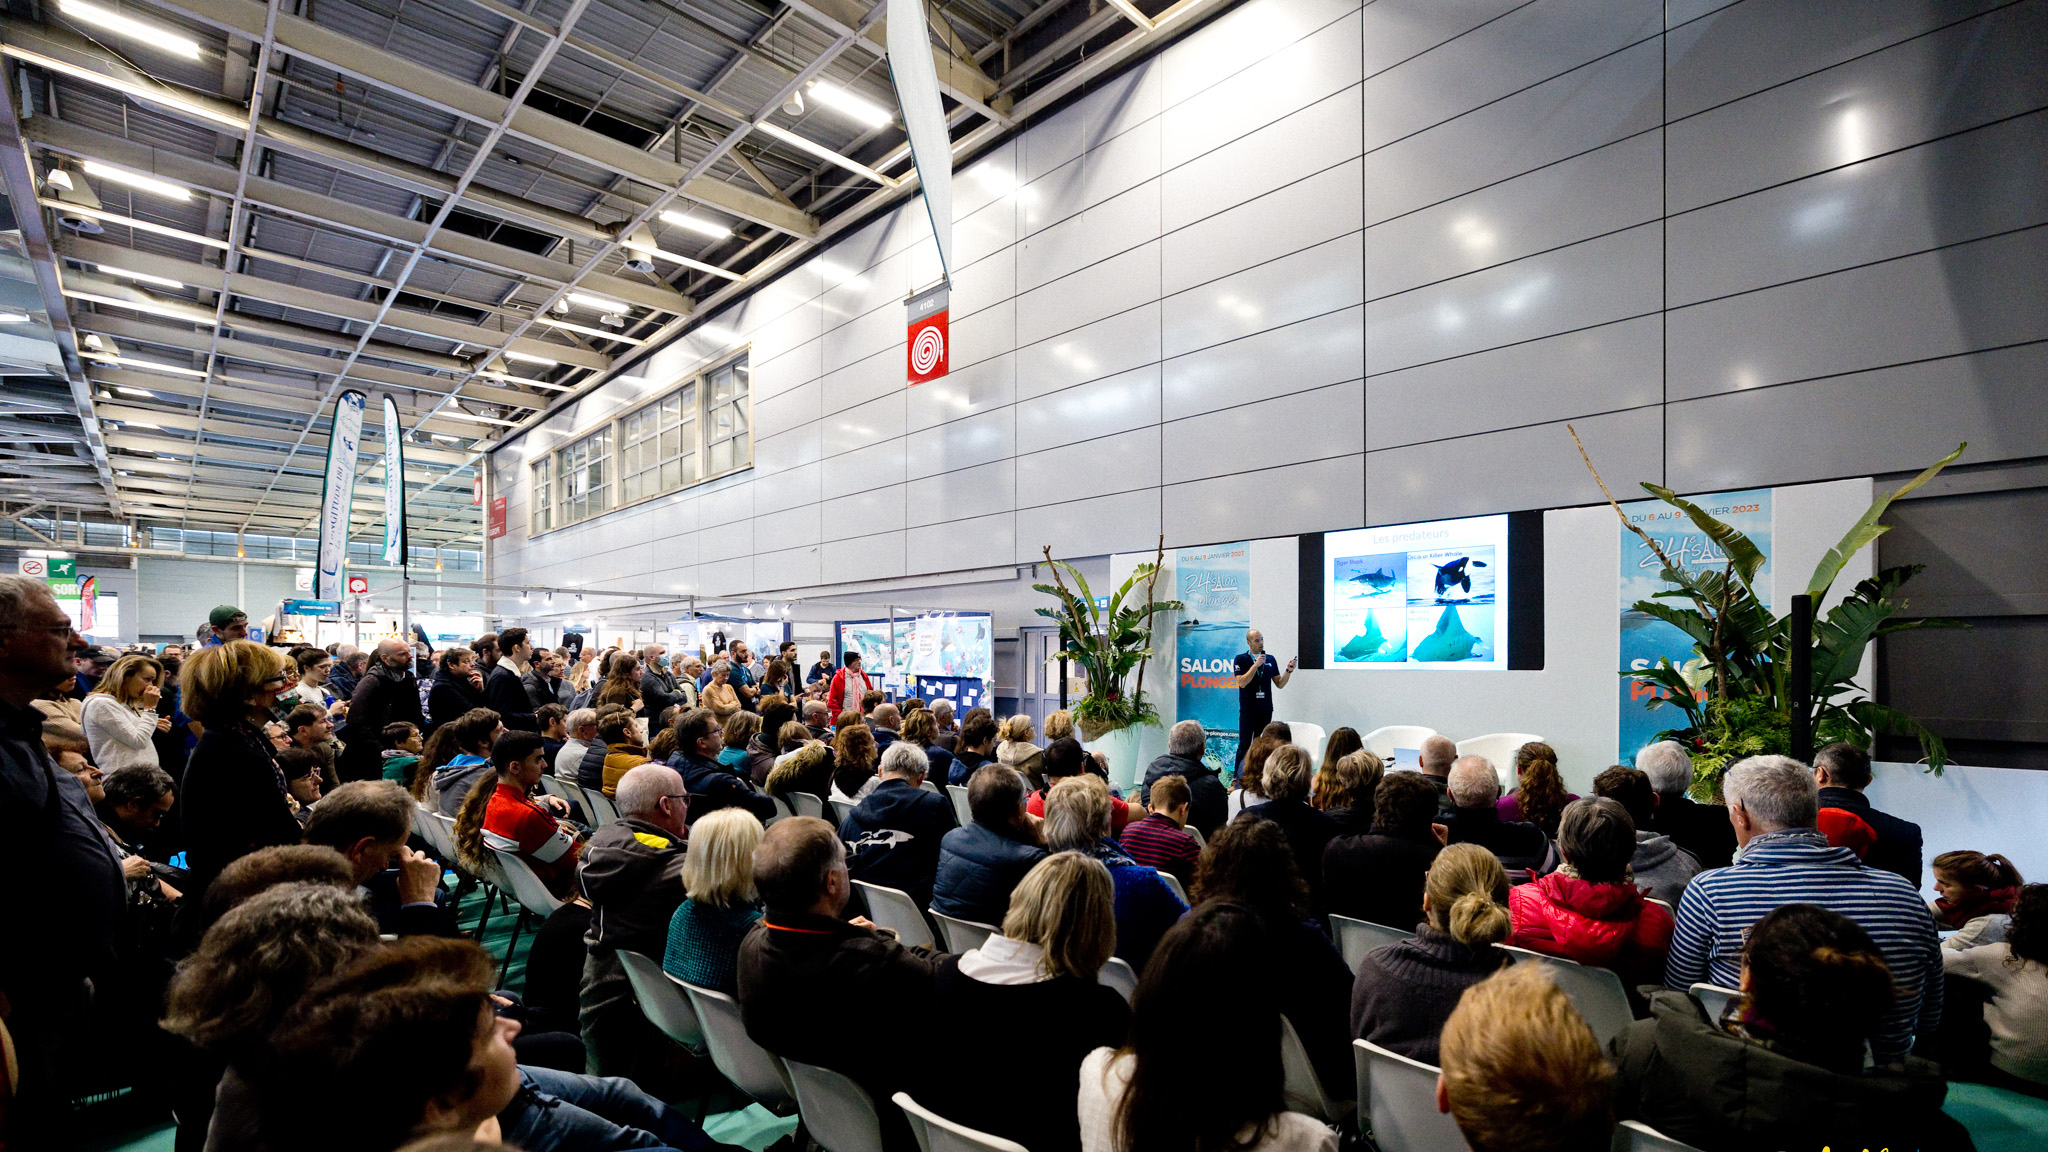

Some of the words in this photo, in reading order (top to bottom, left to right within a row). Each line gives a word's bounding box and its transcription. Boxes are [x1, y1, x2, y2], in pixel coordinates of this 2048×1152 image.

[919, 298, 934, 311] 4102
[1631, 514, 1647, 523] DU
[1648, 513, 1655, 521] 6
[1657, 511, 1673, 521] AU
[1674, 511, 1682, 519] 9
[1731, 504, 1760, 514] 2023
[1373, 534, 1390, 545] Les
[1207, 551, 1230, 560] JANVIER
[53, 583, 81, 596] SORT
[1180, 657, 1235, 673] SALON
